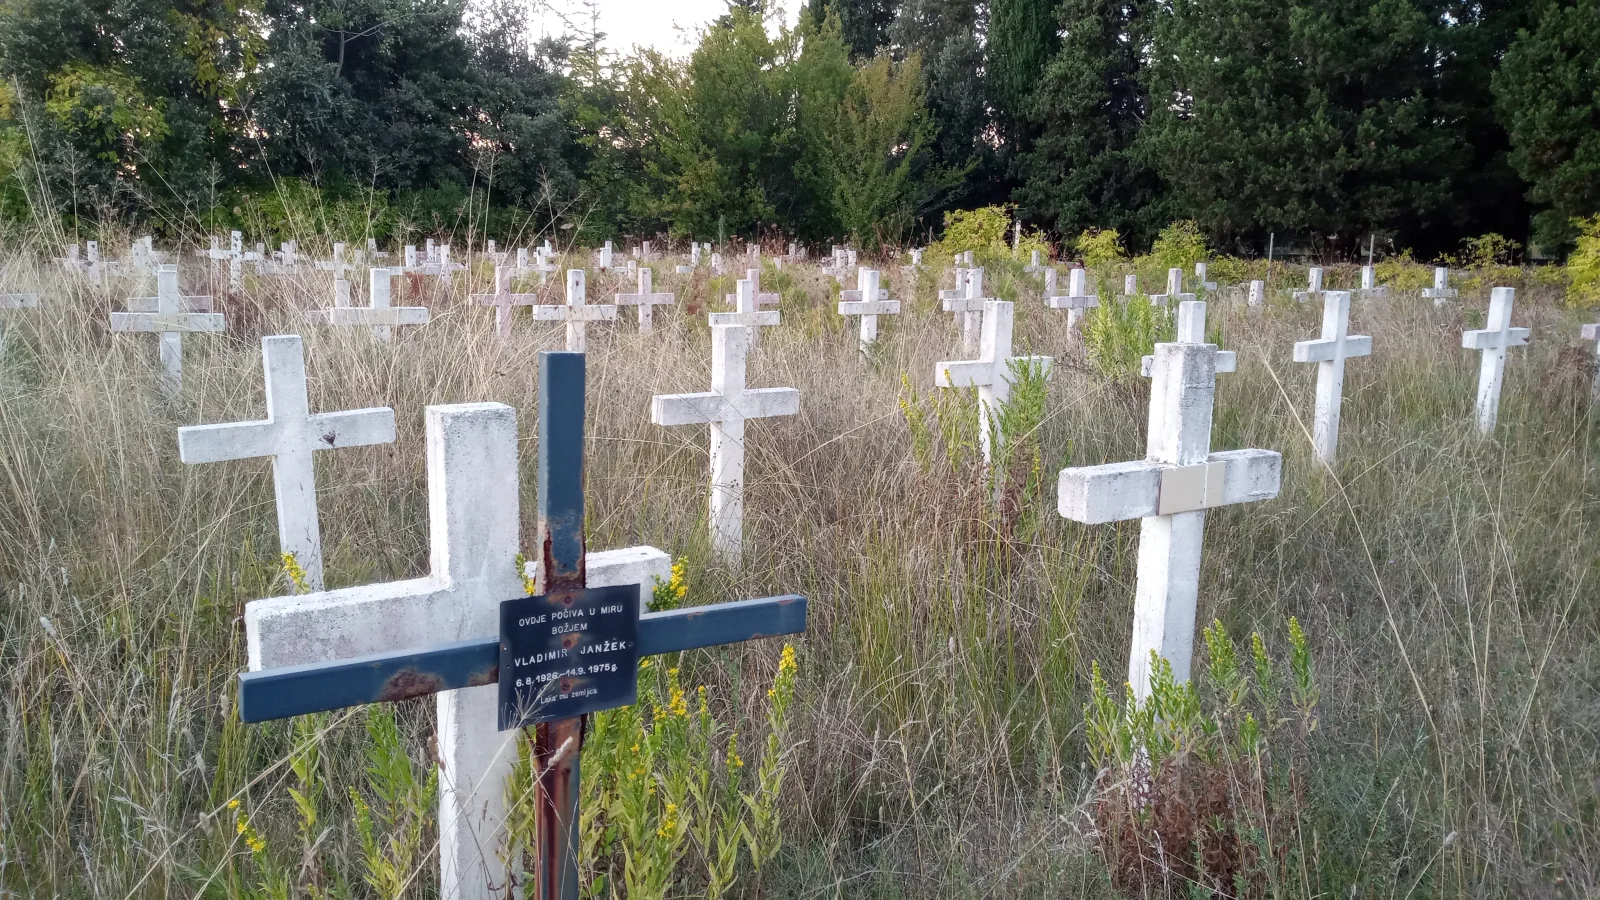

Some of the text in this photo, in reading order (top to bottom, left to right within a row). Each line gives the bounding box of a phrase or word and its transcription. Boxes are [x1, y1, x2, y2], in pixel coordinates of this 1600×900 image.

[518, 604, 623, 627] OVDJE POČIVA U MIRU
[551, 622, 588, 635] BOŽJEM
[514, 640, 626, 668] VLADIMIR JANŽEK
[571, 688, 598, 698] zemljica
